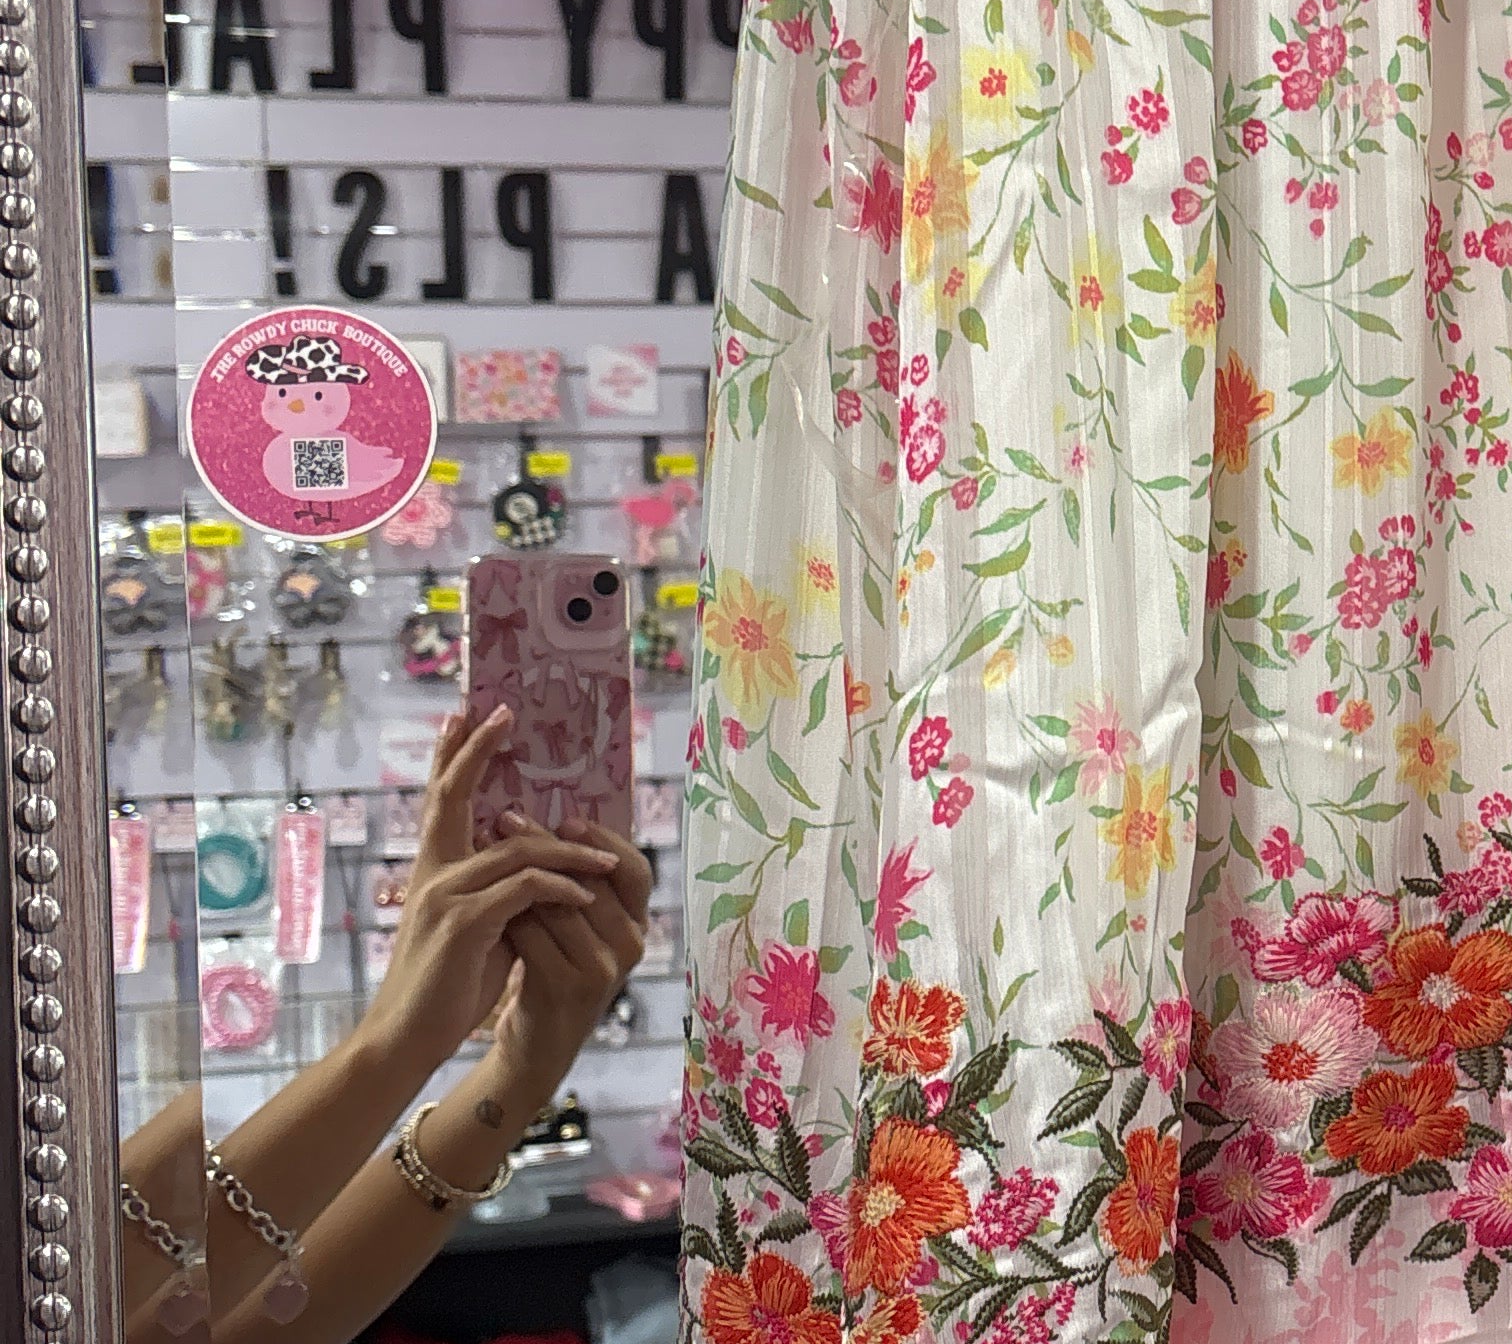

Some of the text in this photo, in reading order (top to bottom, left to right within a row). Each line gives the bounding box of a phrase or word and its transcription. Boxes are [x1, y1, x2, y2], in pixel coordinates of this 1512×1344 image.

[209, 318, 409, 384] THE ROWDY CHICK BOUTIQUE
